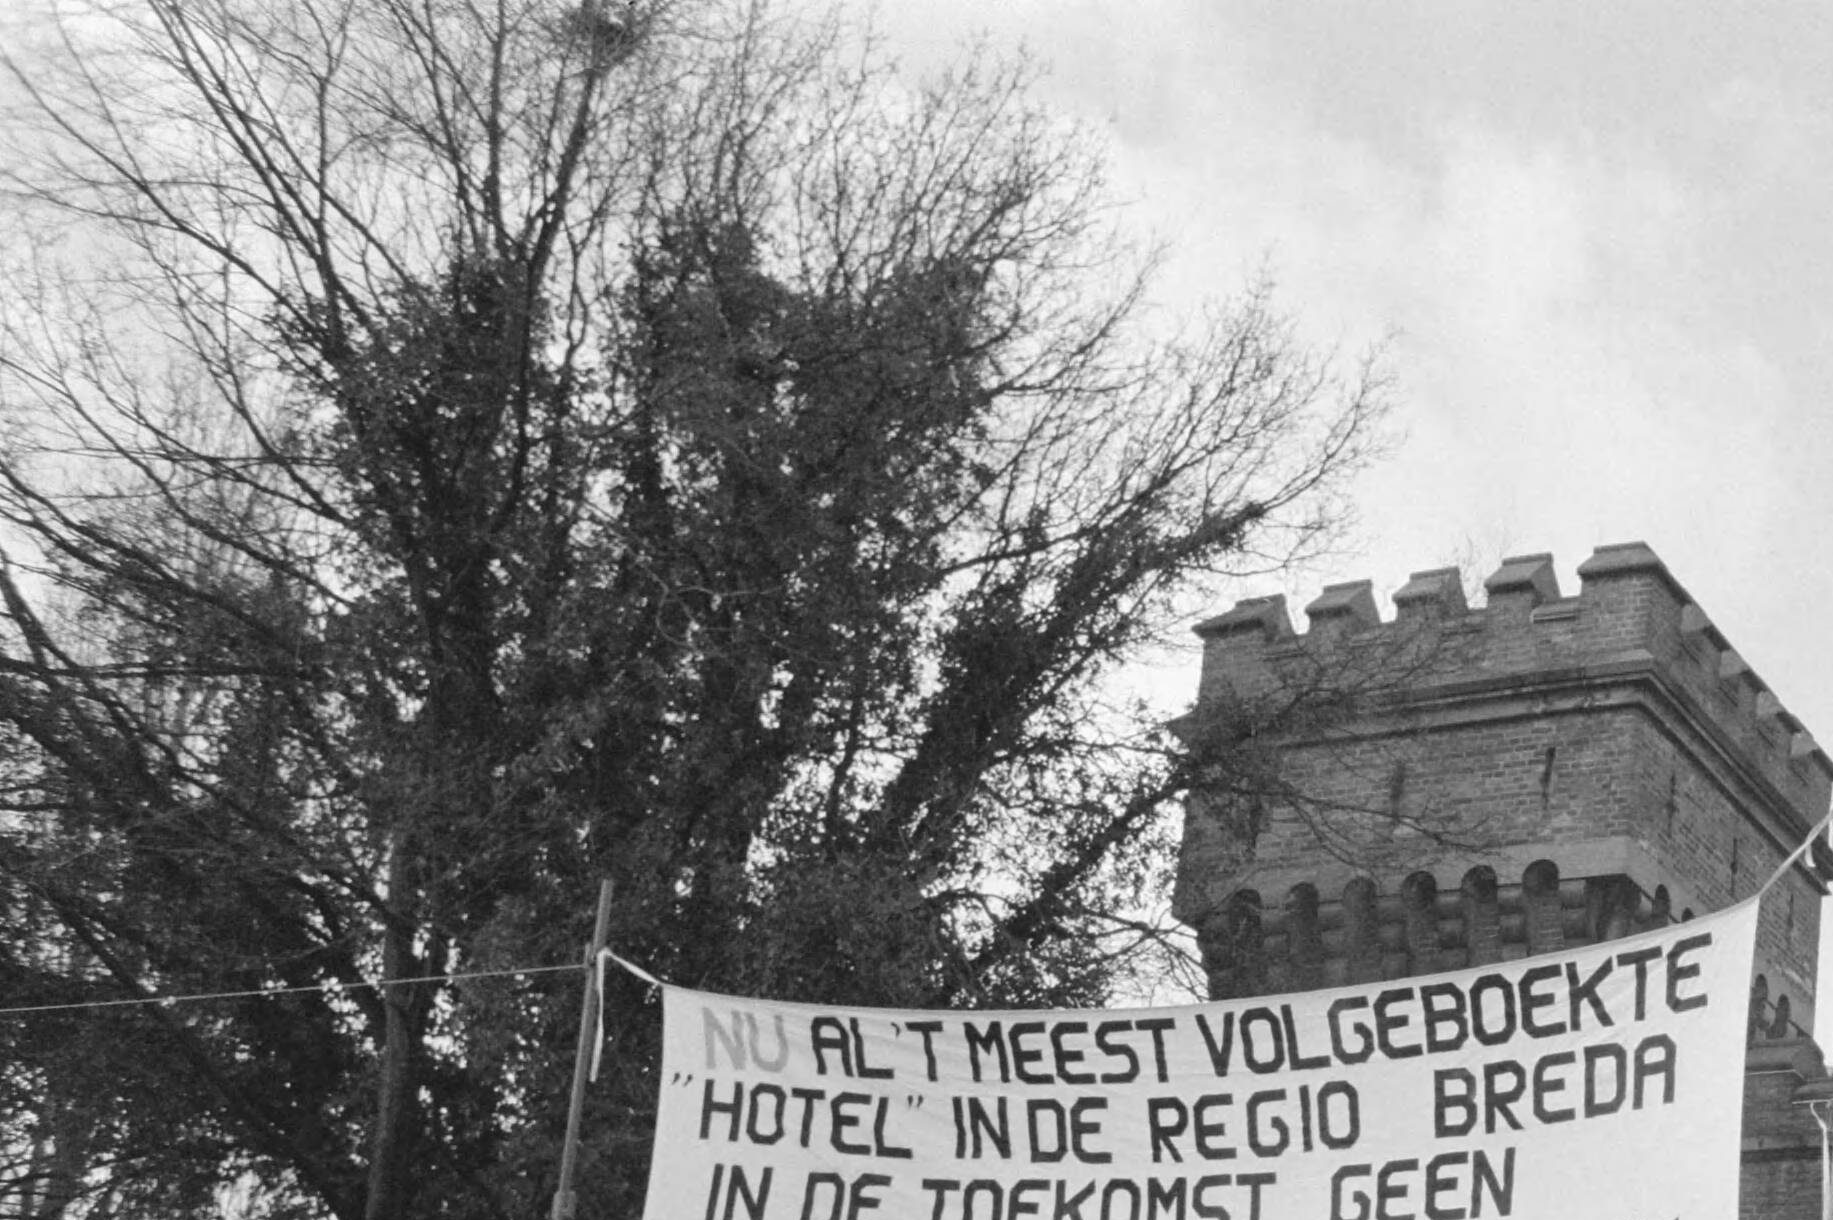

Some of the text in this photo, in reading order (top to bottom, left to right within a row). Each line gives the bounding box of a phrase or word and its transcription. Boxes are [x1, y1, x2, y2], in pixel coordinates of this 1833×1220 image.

[702, 1007, 789, 1073] NU
[962, 1017, 1176, 1085] MEEST
[1195, 933, 1712, 1077] VOLGEBOEKTE
[1147, 1080, 1360, 1163] REGIO
[1434, 1033, 1677, 1139] BREDA
